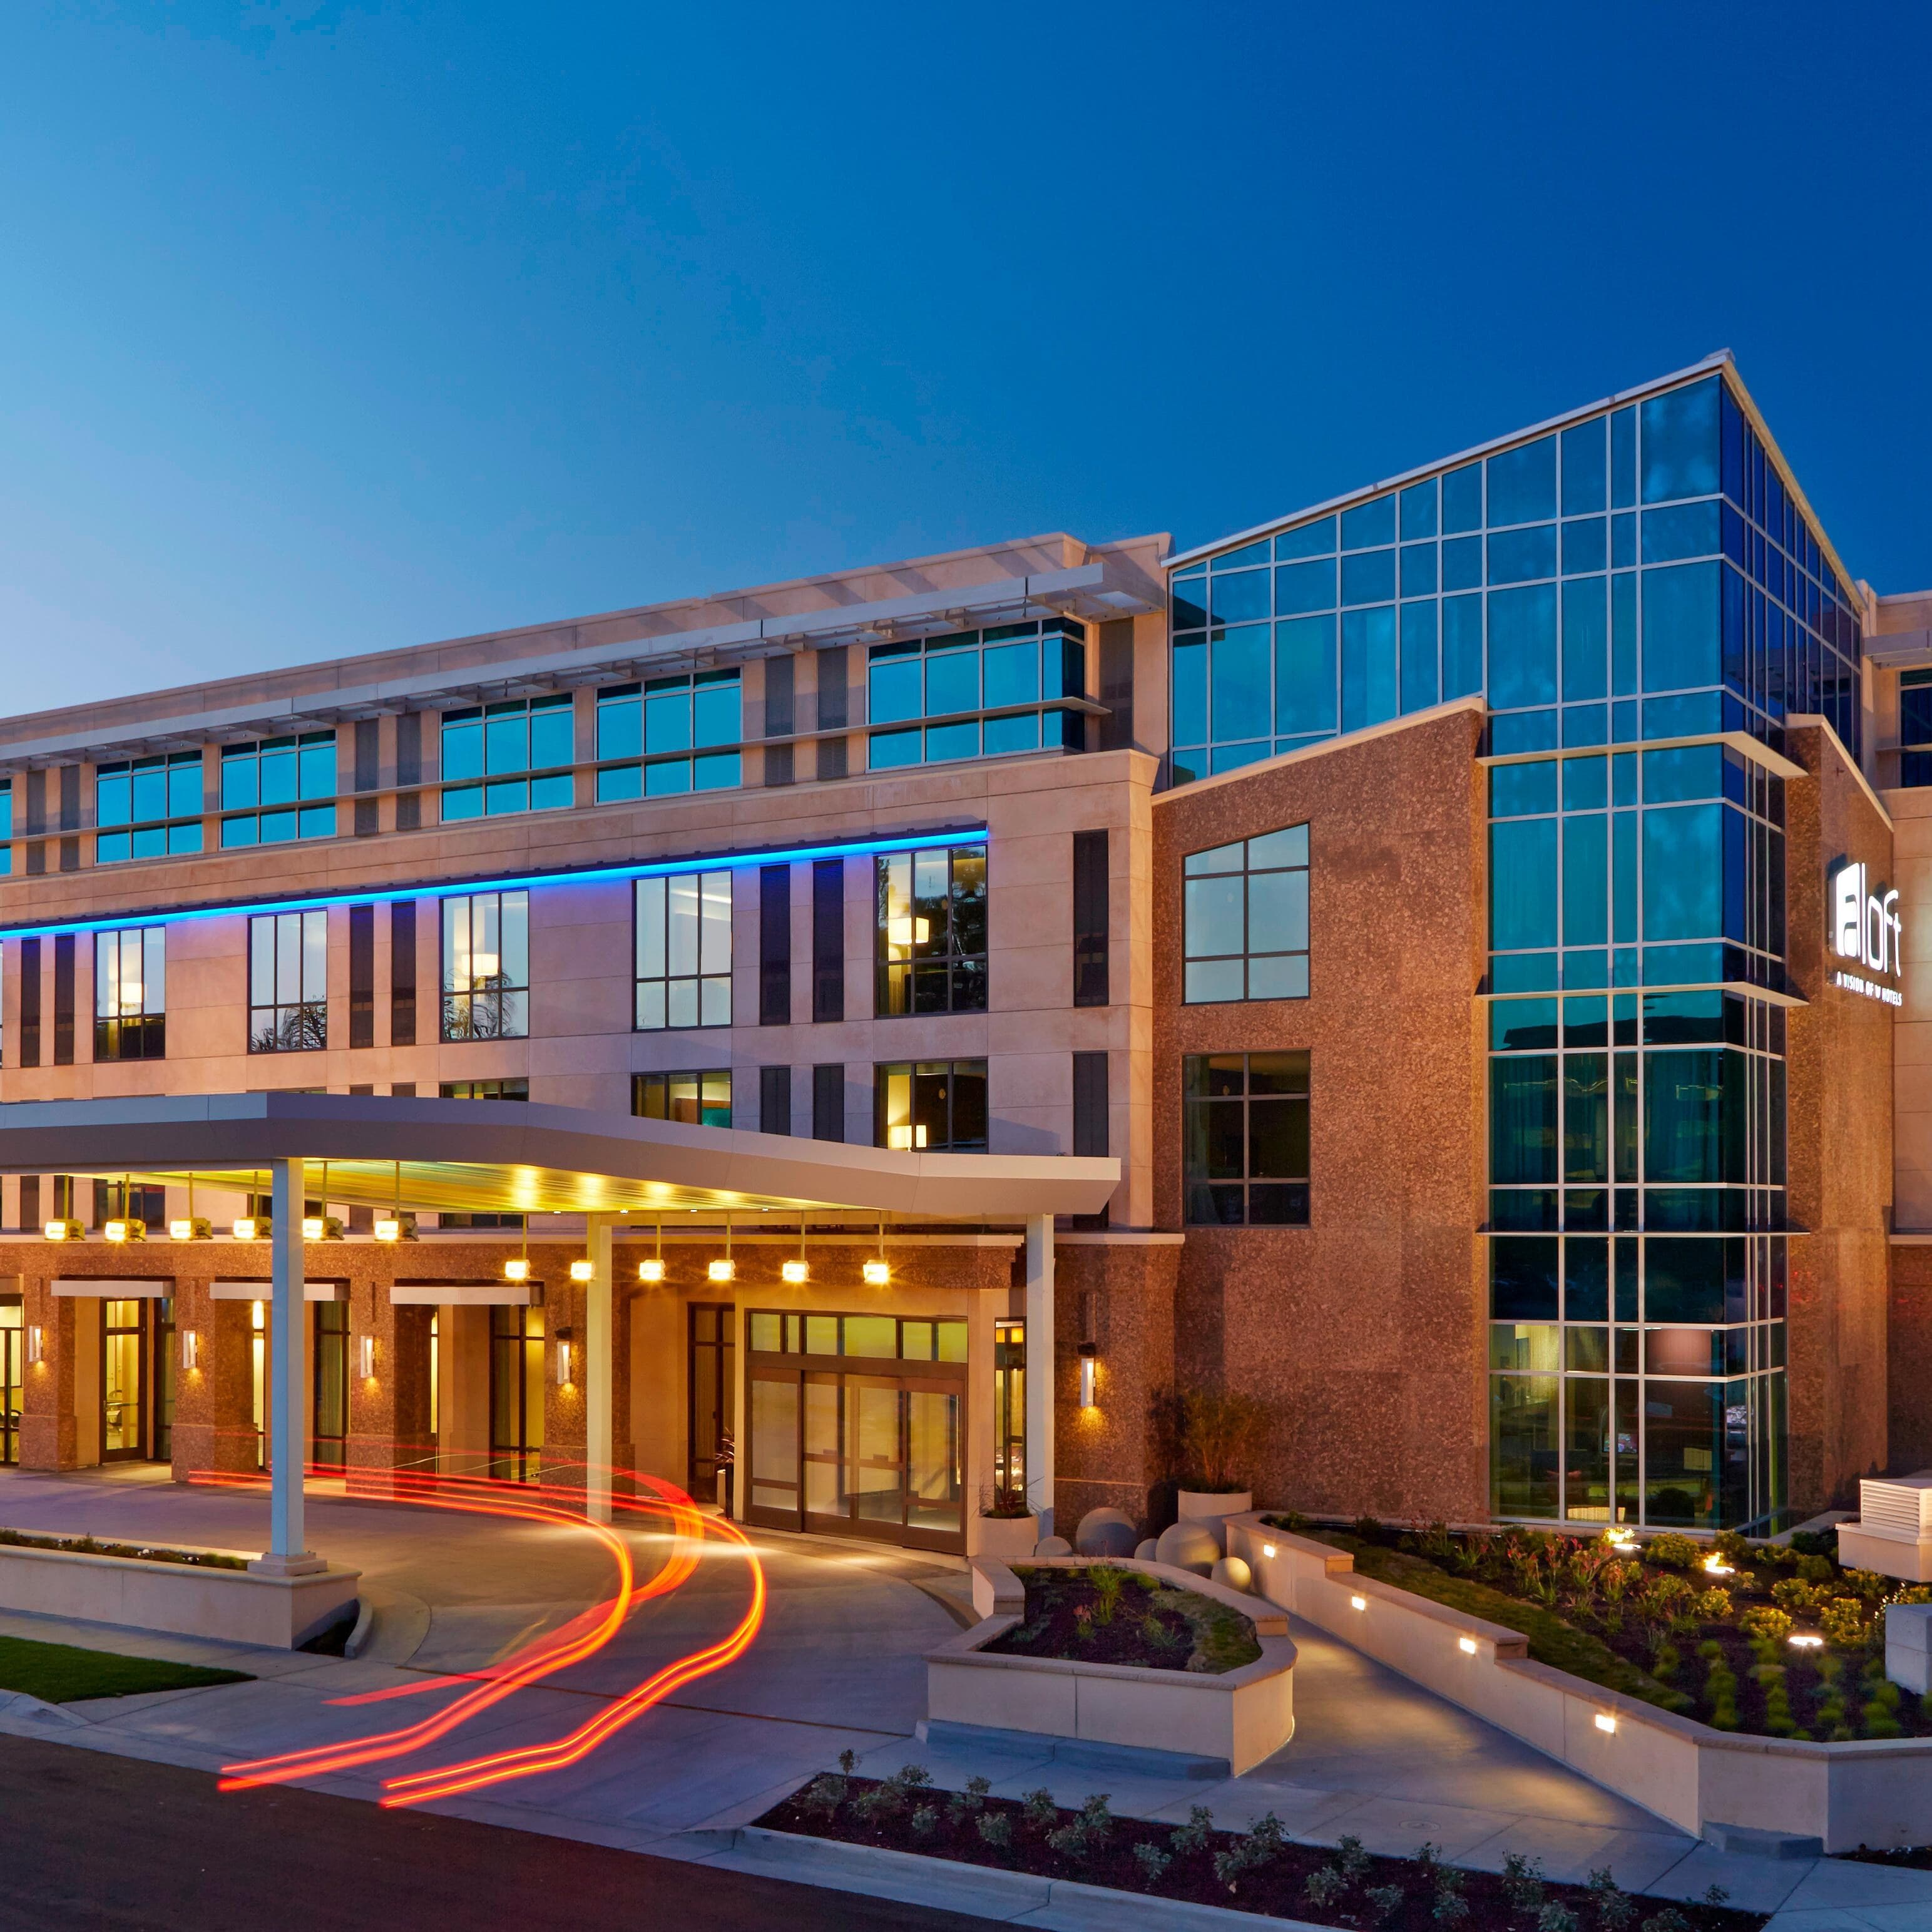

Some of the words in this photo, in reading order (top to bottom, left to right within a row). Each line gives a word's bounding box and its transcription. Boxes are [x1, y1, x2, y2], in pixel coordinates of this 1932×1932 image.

[1836, 862, 1901, 977] aloft
[1836, 971, 1841, 986] A
[1843, 974, 1864, 993] VISION
[1865, 981, 1874, 996] OF
[1882, 988, 1902, 1006] HOTELS
